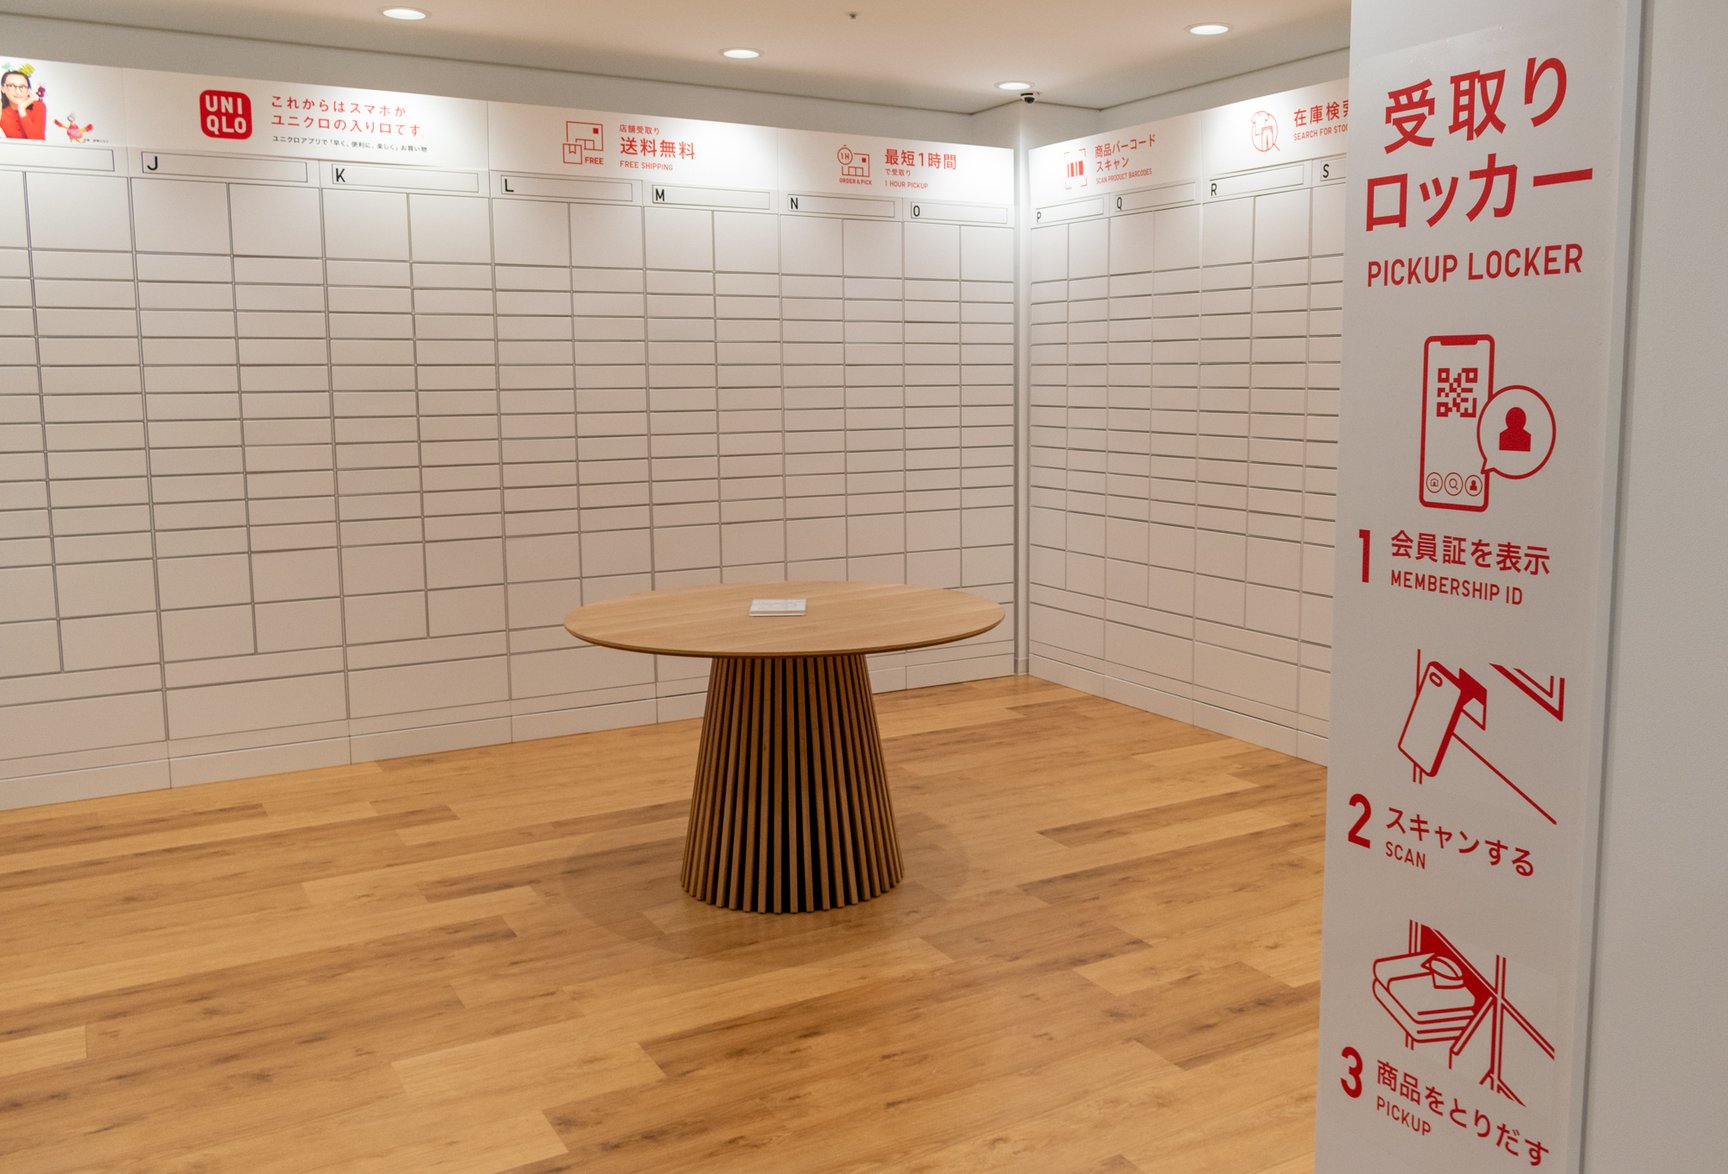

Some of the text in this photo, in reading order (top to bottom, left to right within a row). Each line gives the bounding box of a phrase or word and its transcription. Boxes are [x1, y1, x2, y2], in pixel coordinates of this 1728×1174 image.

[205, 95, 243, 114] UNI
[271, 96, 406, 117] これからはスマホが
[1383, 57, 1567, 154] 受取り
[206, 115, 247, 135] QLO
[619, 124, 660, 135] 店舗受取り
[1293, 131, 1318, 141] SEARCH
[1320, 127, 1333, 135] FOR
[620, 136, 696, 160] 送料無料
[1095, 134, 1156, 158] 商品バーコード
[147, 156, 158, 170] J
[584, 157, 604, 165] FREE
[620, 160, 673, 171] FREE SHIPPING
[885, 148, 957, 170] 最短1時間
[1096, 157, 1130, 173] スキャン
[335, 168, 346, 182] K
[885, 168, 911, 177] で受取り
[1108, 173, 1128, 182] PRODUCT
[1128, 168, 1153, 179] BARCODES
[1323, 163, 1330, 178] S
[505, 178, 514, 192] L
[1211, 183, 1218, 197] R
[1366, 153, 1593, 231] ロッカー
[655, 188, 665, 202] M
[790, 197, 799, 210] N
[1117, 197, 1123, 210] Q
[1036, 211, 1041, 223] P
[1367, 243, 1583, 287] PICKUP LOCKER
[1359, 529, 1370, 583] 1
[1391, 530, 1550, 576] 会員証を表示
[1391, 570, 1523, 605] MEMBERSHIP ID
[1348, 793, 1372, 848] 2
[1386, 807, 1534, 877] スキャンする
[1385, 841, 1426, 869] SCAN
[1340, 1046, 1363, 1098] 3
[1377, 1059, 1550, 1166] 商品をとりだす
[1377, 1096, 1431, 1136] PICKUP
